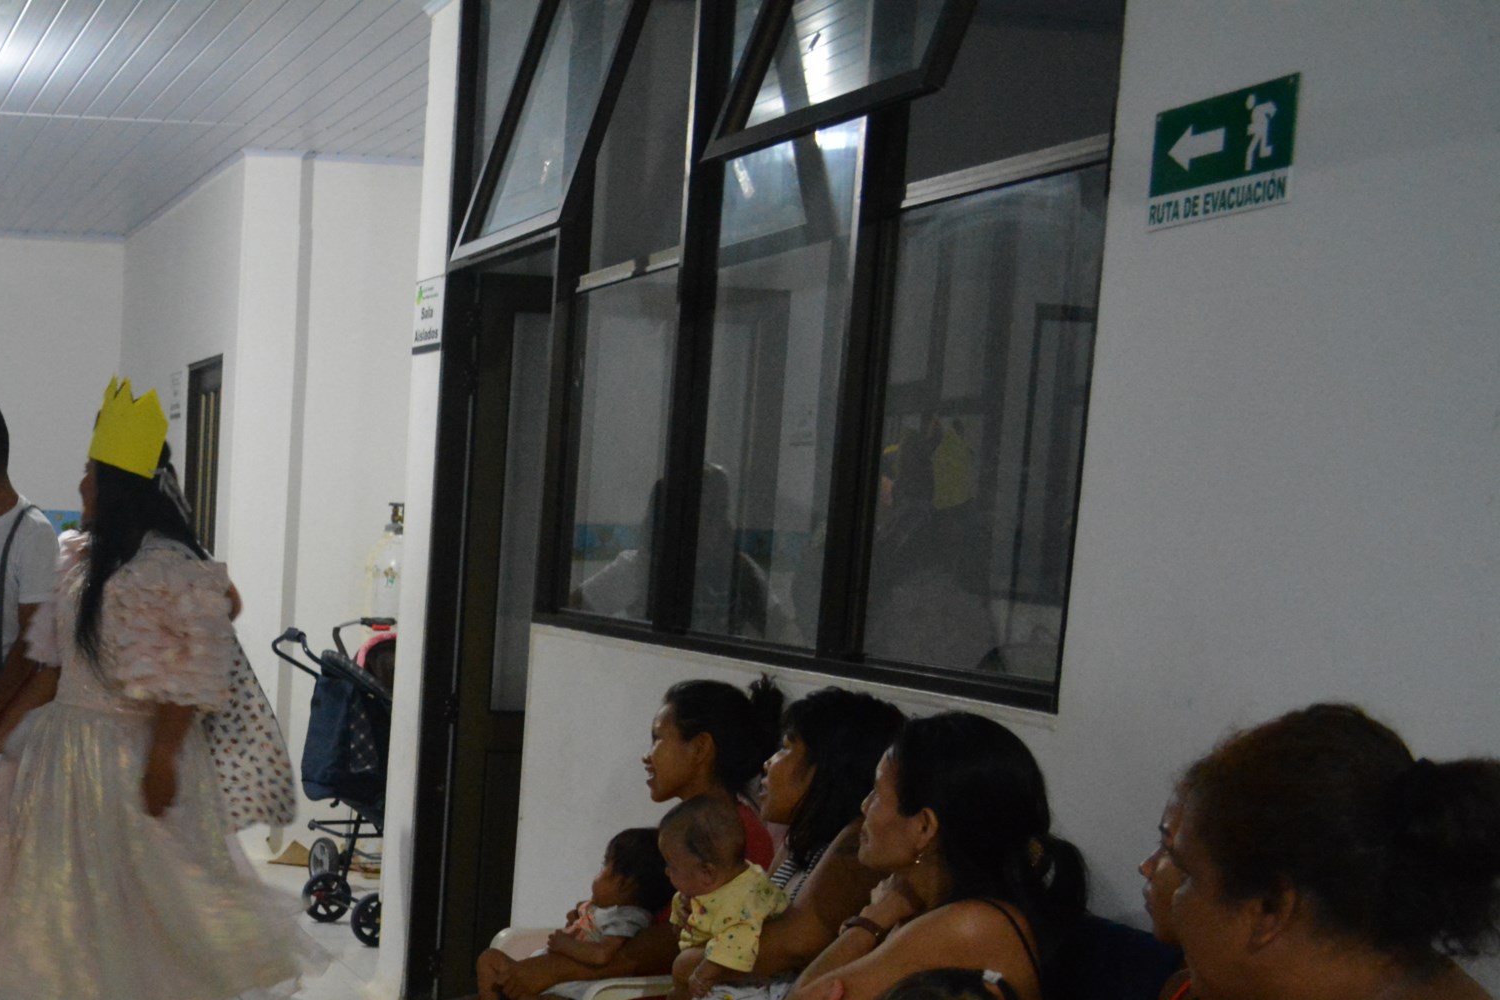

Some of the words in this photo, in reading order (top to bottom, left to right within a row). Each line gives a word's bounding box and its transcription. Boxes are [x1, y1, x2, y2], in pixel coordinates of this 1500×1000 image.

[1148, 200, 1180, 225] RUTA
[1183, 195, 1200, 219] DE
[1202, 172, 1287, 215] EVACUACIÓN
[421, 306, 433, 320] Sala
[414, 327, 438, 342] Aislados
